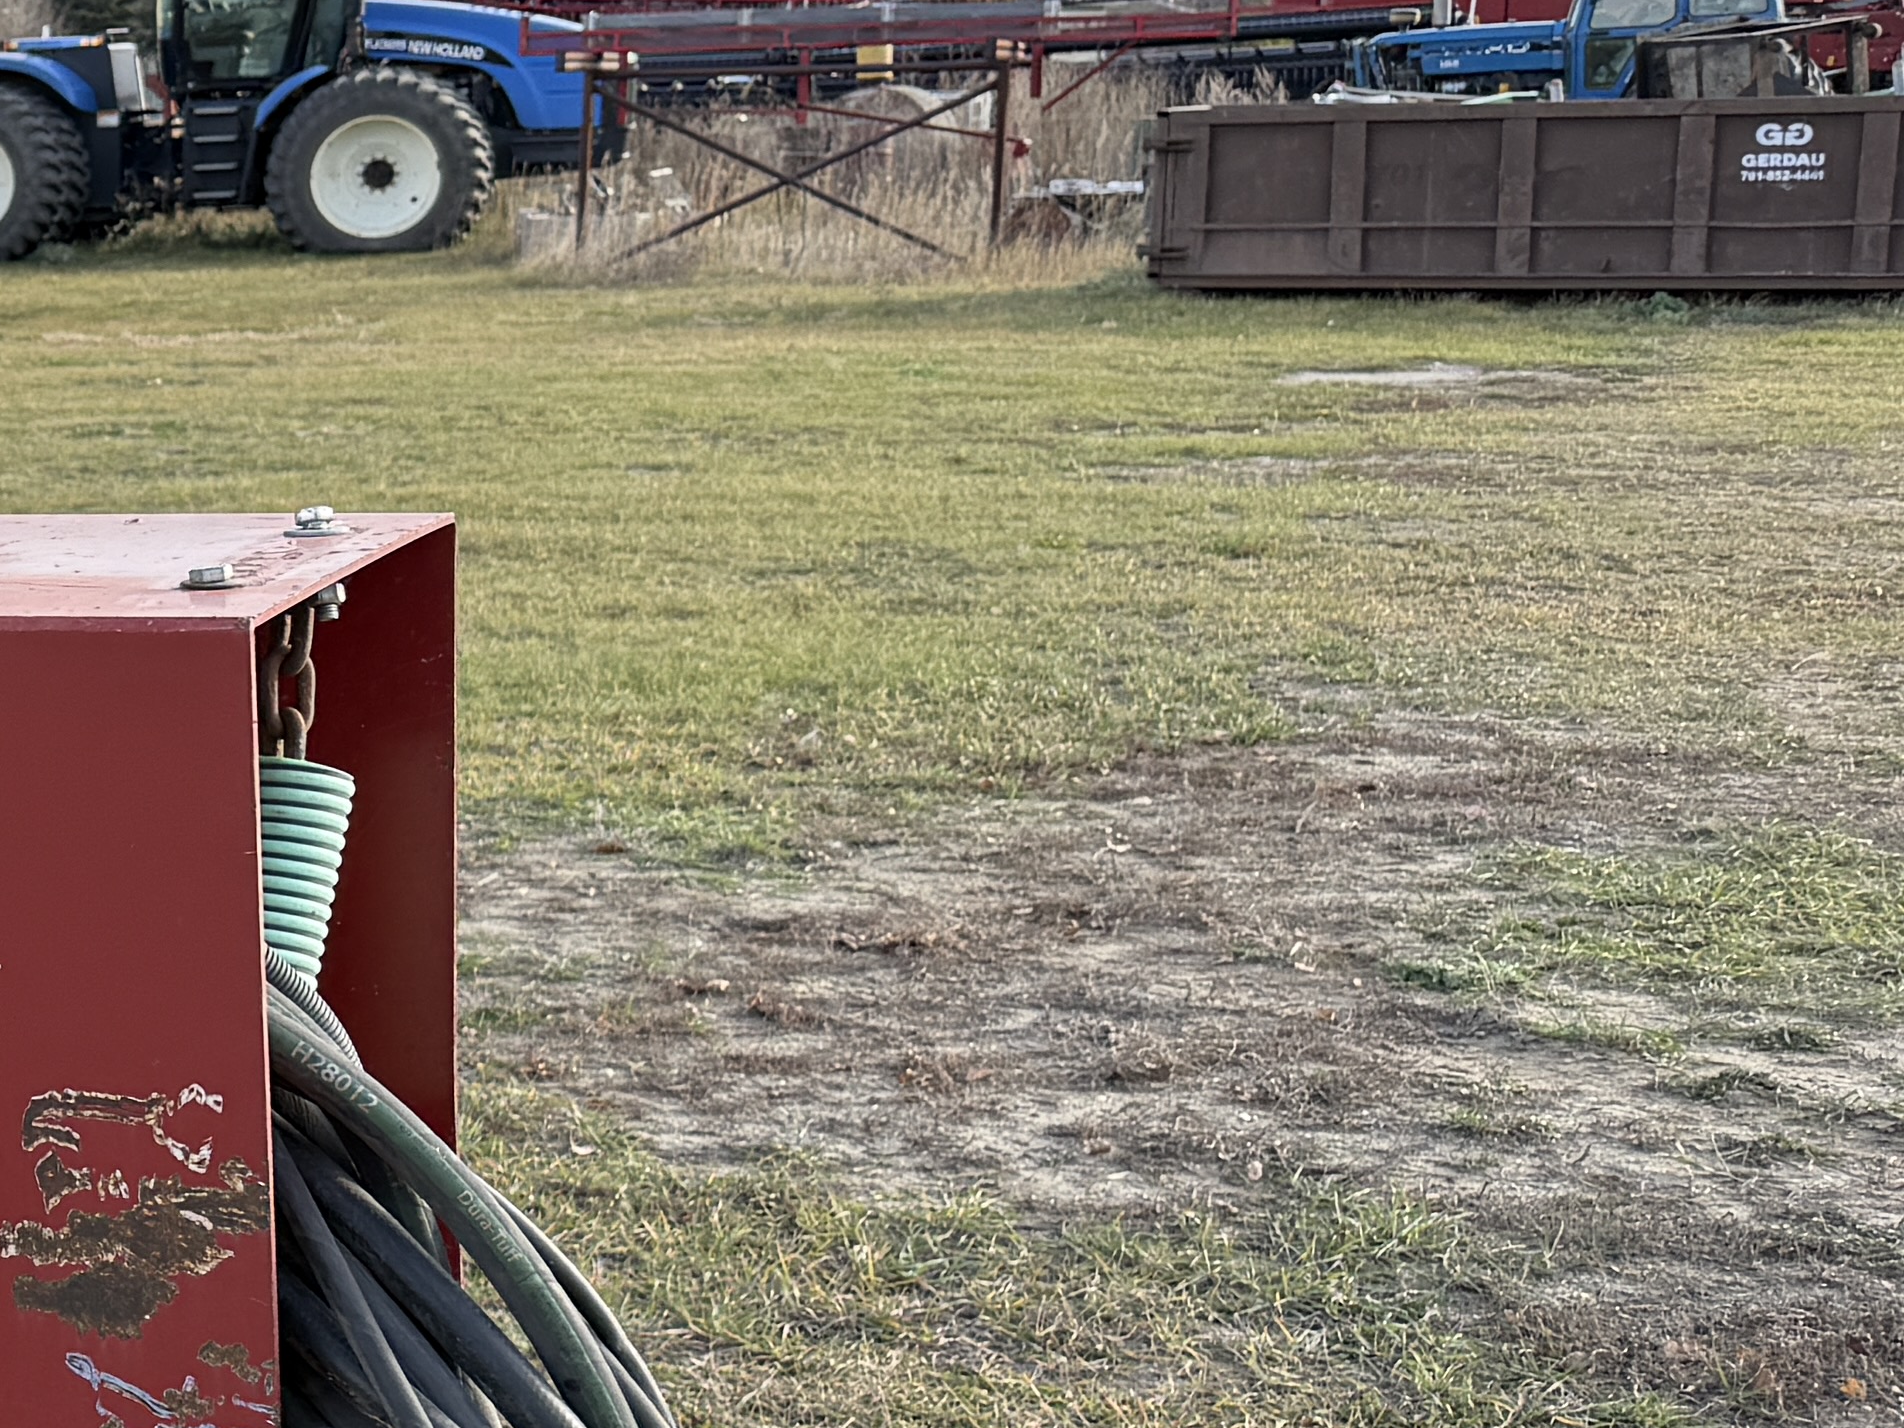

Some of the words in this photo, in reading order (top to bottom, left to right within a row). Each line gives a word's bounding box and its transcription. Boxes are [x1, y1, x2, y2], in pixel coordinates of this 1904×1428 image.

[408, 40, 432, 55] NEW
[432, 42, 485, 61] HOLLAND
[1741, 153, 1826, 168] GERDAU
[1740, 170, 1825, 182] 701-852-4441
[290, 1038, 379, 1115] H28012
[456, 1188, 525, 1265] Dura-Tuff
